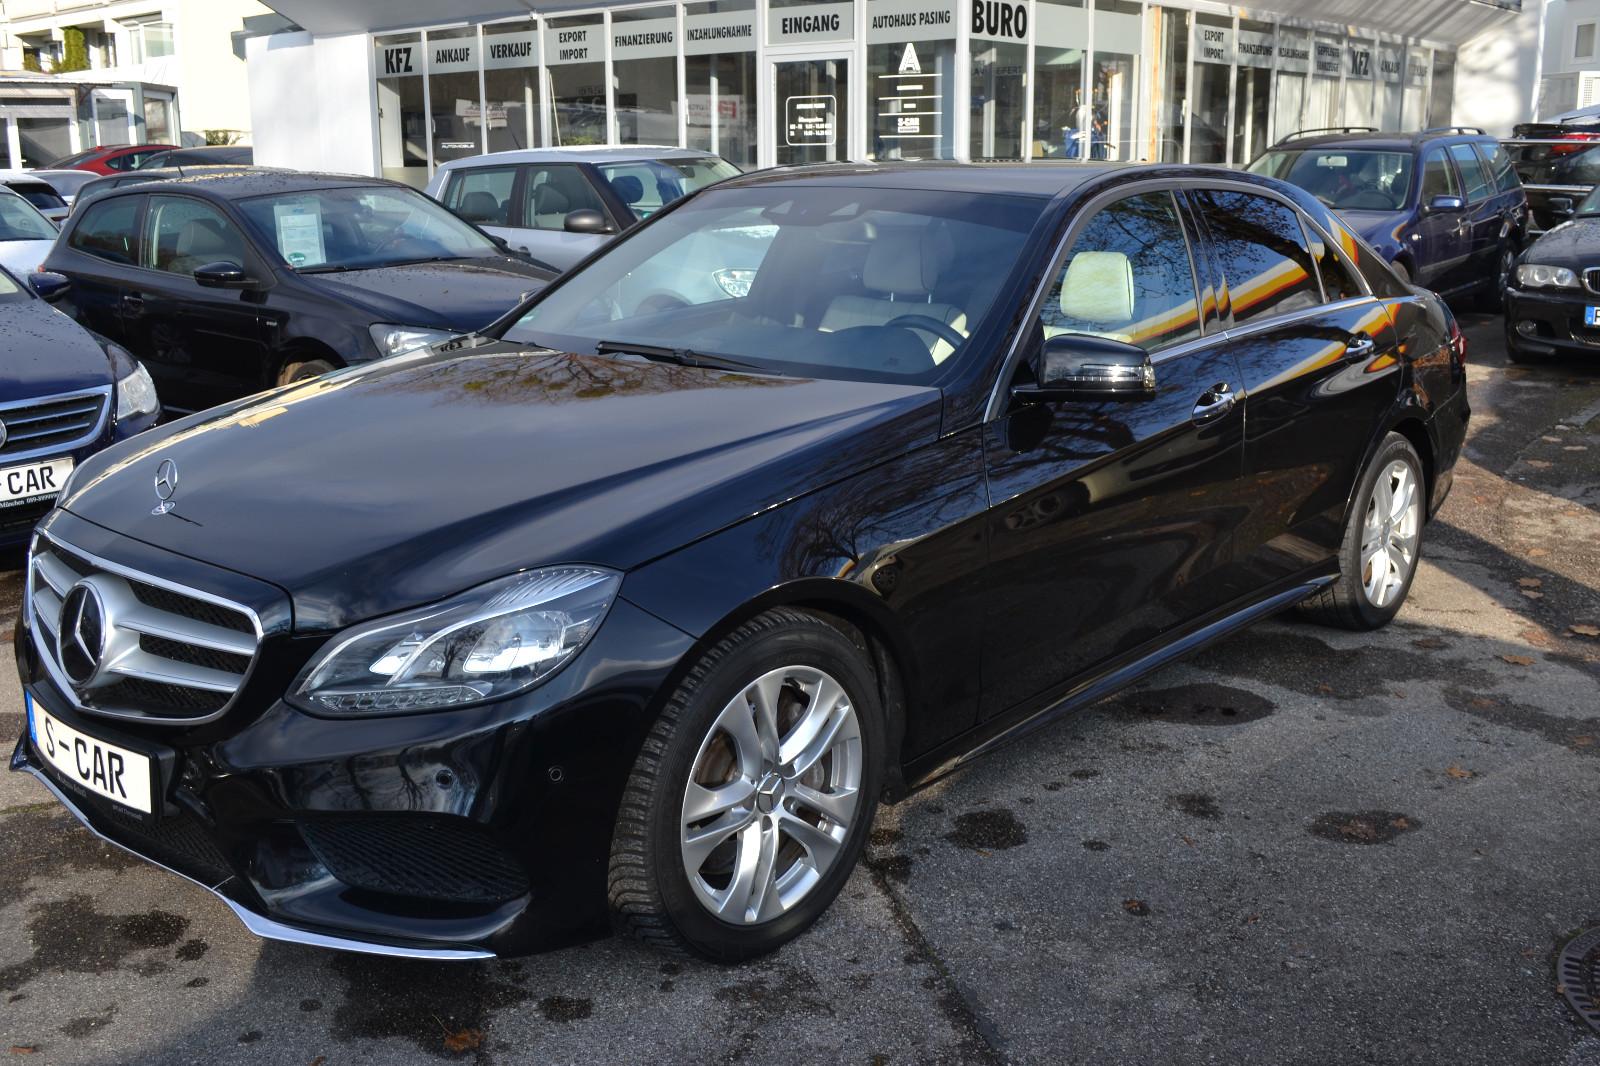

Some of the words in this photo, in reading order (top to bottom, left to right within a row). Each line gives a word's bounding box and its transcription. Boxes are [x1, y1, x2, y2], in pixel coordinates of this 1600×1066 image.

[781, 14, 840, 34] EINGANG
[872, 12, 917, 29] AUTOHAUS
[919, 10, 951, 26] PASING
[559, 30, 587, 44] EXPORT
[615, 31, 673, 47] FINANZIERUNG
[687, 24, 752, 41] INZAHLUNGNAHME
[1204, 30, 1225, 43] EXPORT
[435, 47, 470, 64] ANKAUF
[490, 42, 532, 59] VERKAUF
[559, 47, 588, 61] IMPORT
[1203, 47, 1224, 60] IMPORT
[384, 47, 413, 74] KFZ
[1351, 50, 1370, 76] KFZ
[0, 465, 56, 495] CAR
